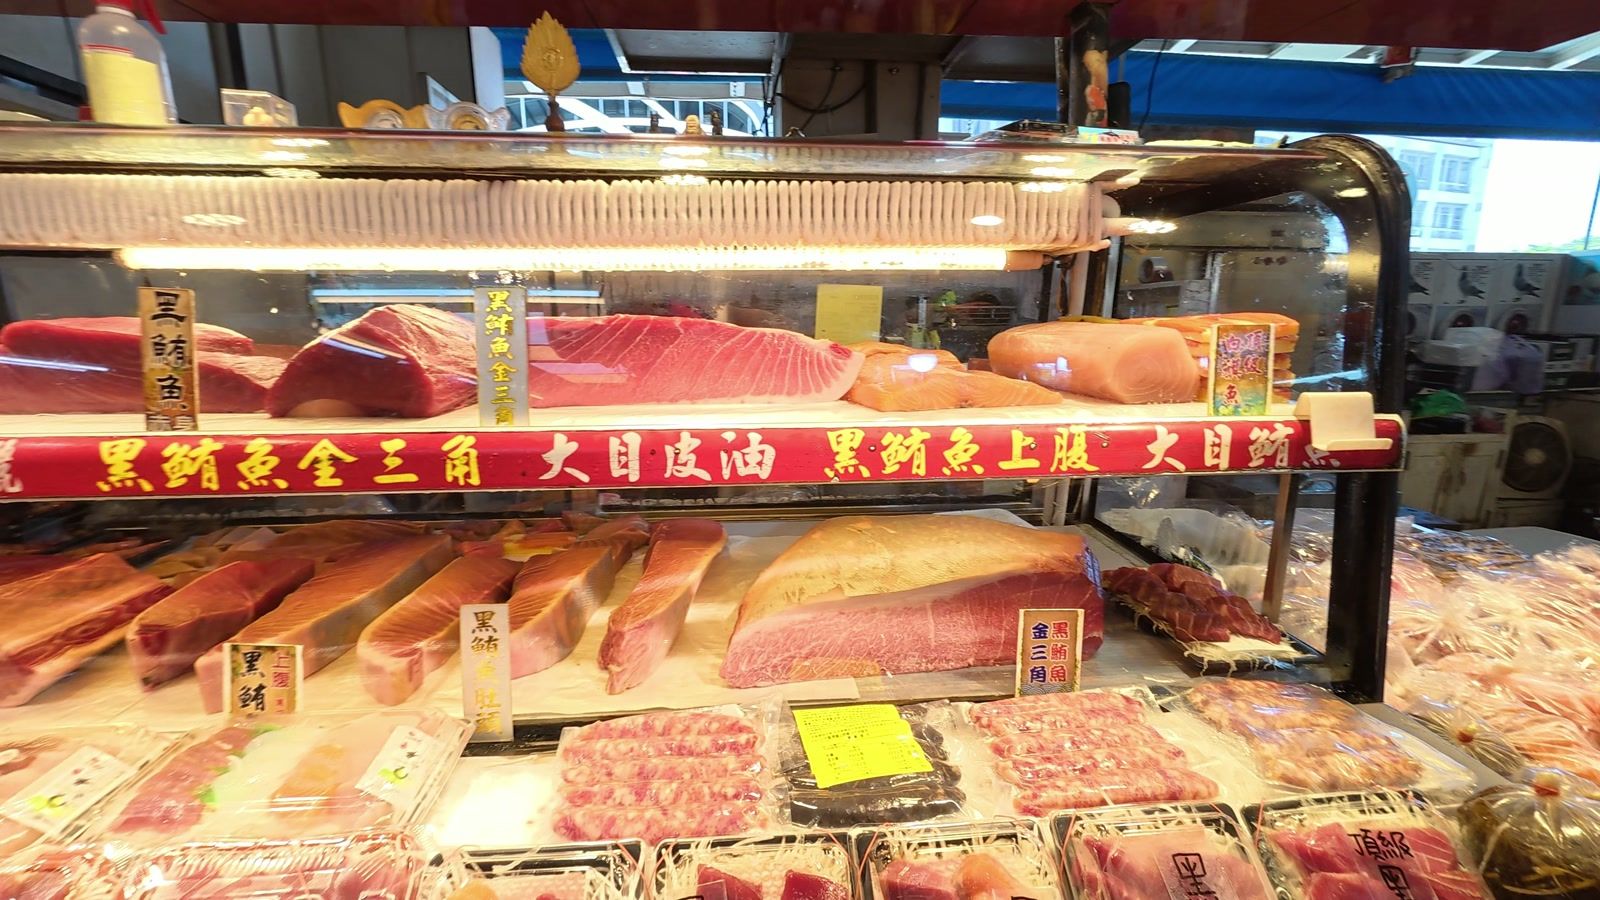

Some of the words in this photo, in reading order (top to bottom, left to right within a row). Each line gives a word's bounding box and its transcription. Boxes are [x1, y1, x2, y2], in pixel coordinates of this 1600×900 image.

[96, 434, 482, 493] 黑鮪魚金三角
[539, 431, 777, 484] 大目皮油
[823, 425, 1100, 480] 黑鮪魚上腹
[1029, 622, 1049, 683] 金三角
[1049, 621, 1069, 682] 黑鮪魚
[238, 650, 267, 719] 黑鮪
[1347, 828, 1414, 861] 頂級
